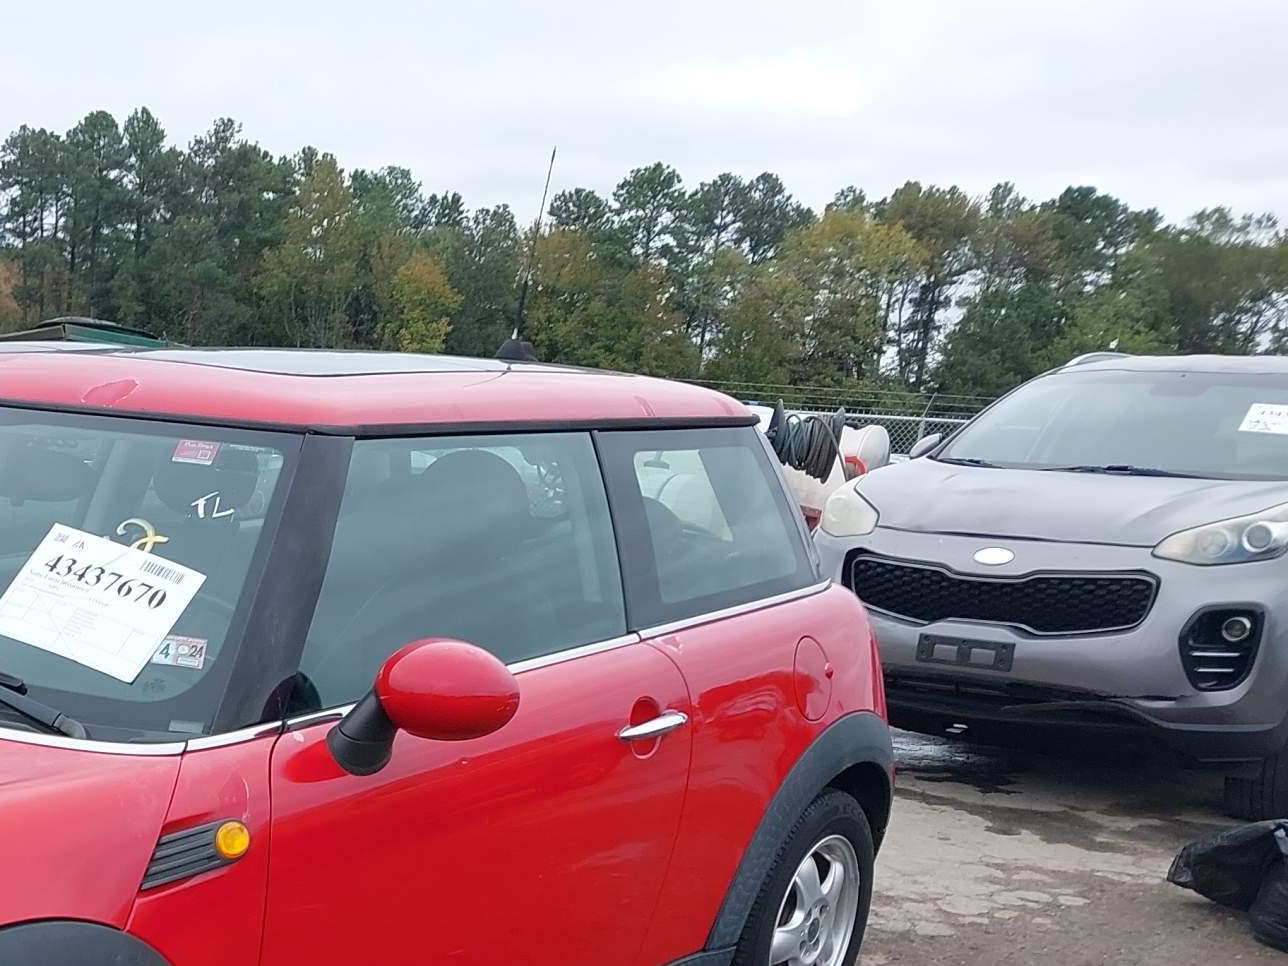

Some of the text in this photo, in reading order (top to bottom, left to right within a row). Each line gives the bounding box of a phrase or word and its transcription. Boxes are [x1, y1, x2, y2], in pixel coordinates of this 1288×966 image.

[191, 491, 235, 519] TL
[44, 554, 167, 609] 43437670
[159, 643, 205, 659] 4 24
